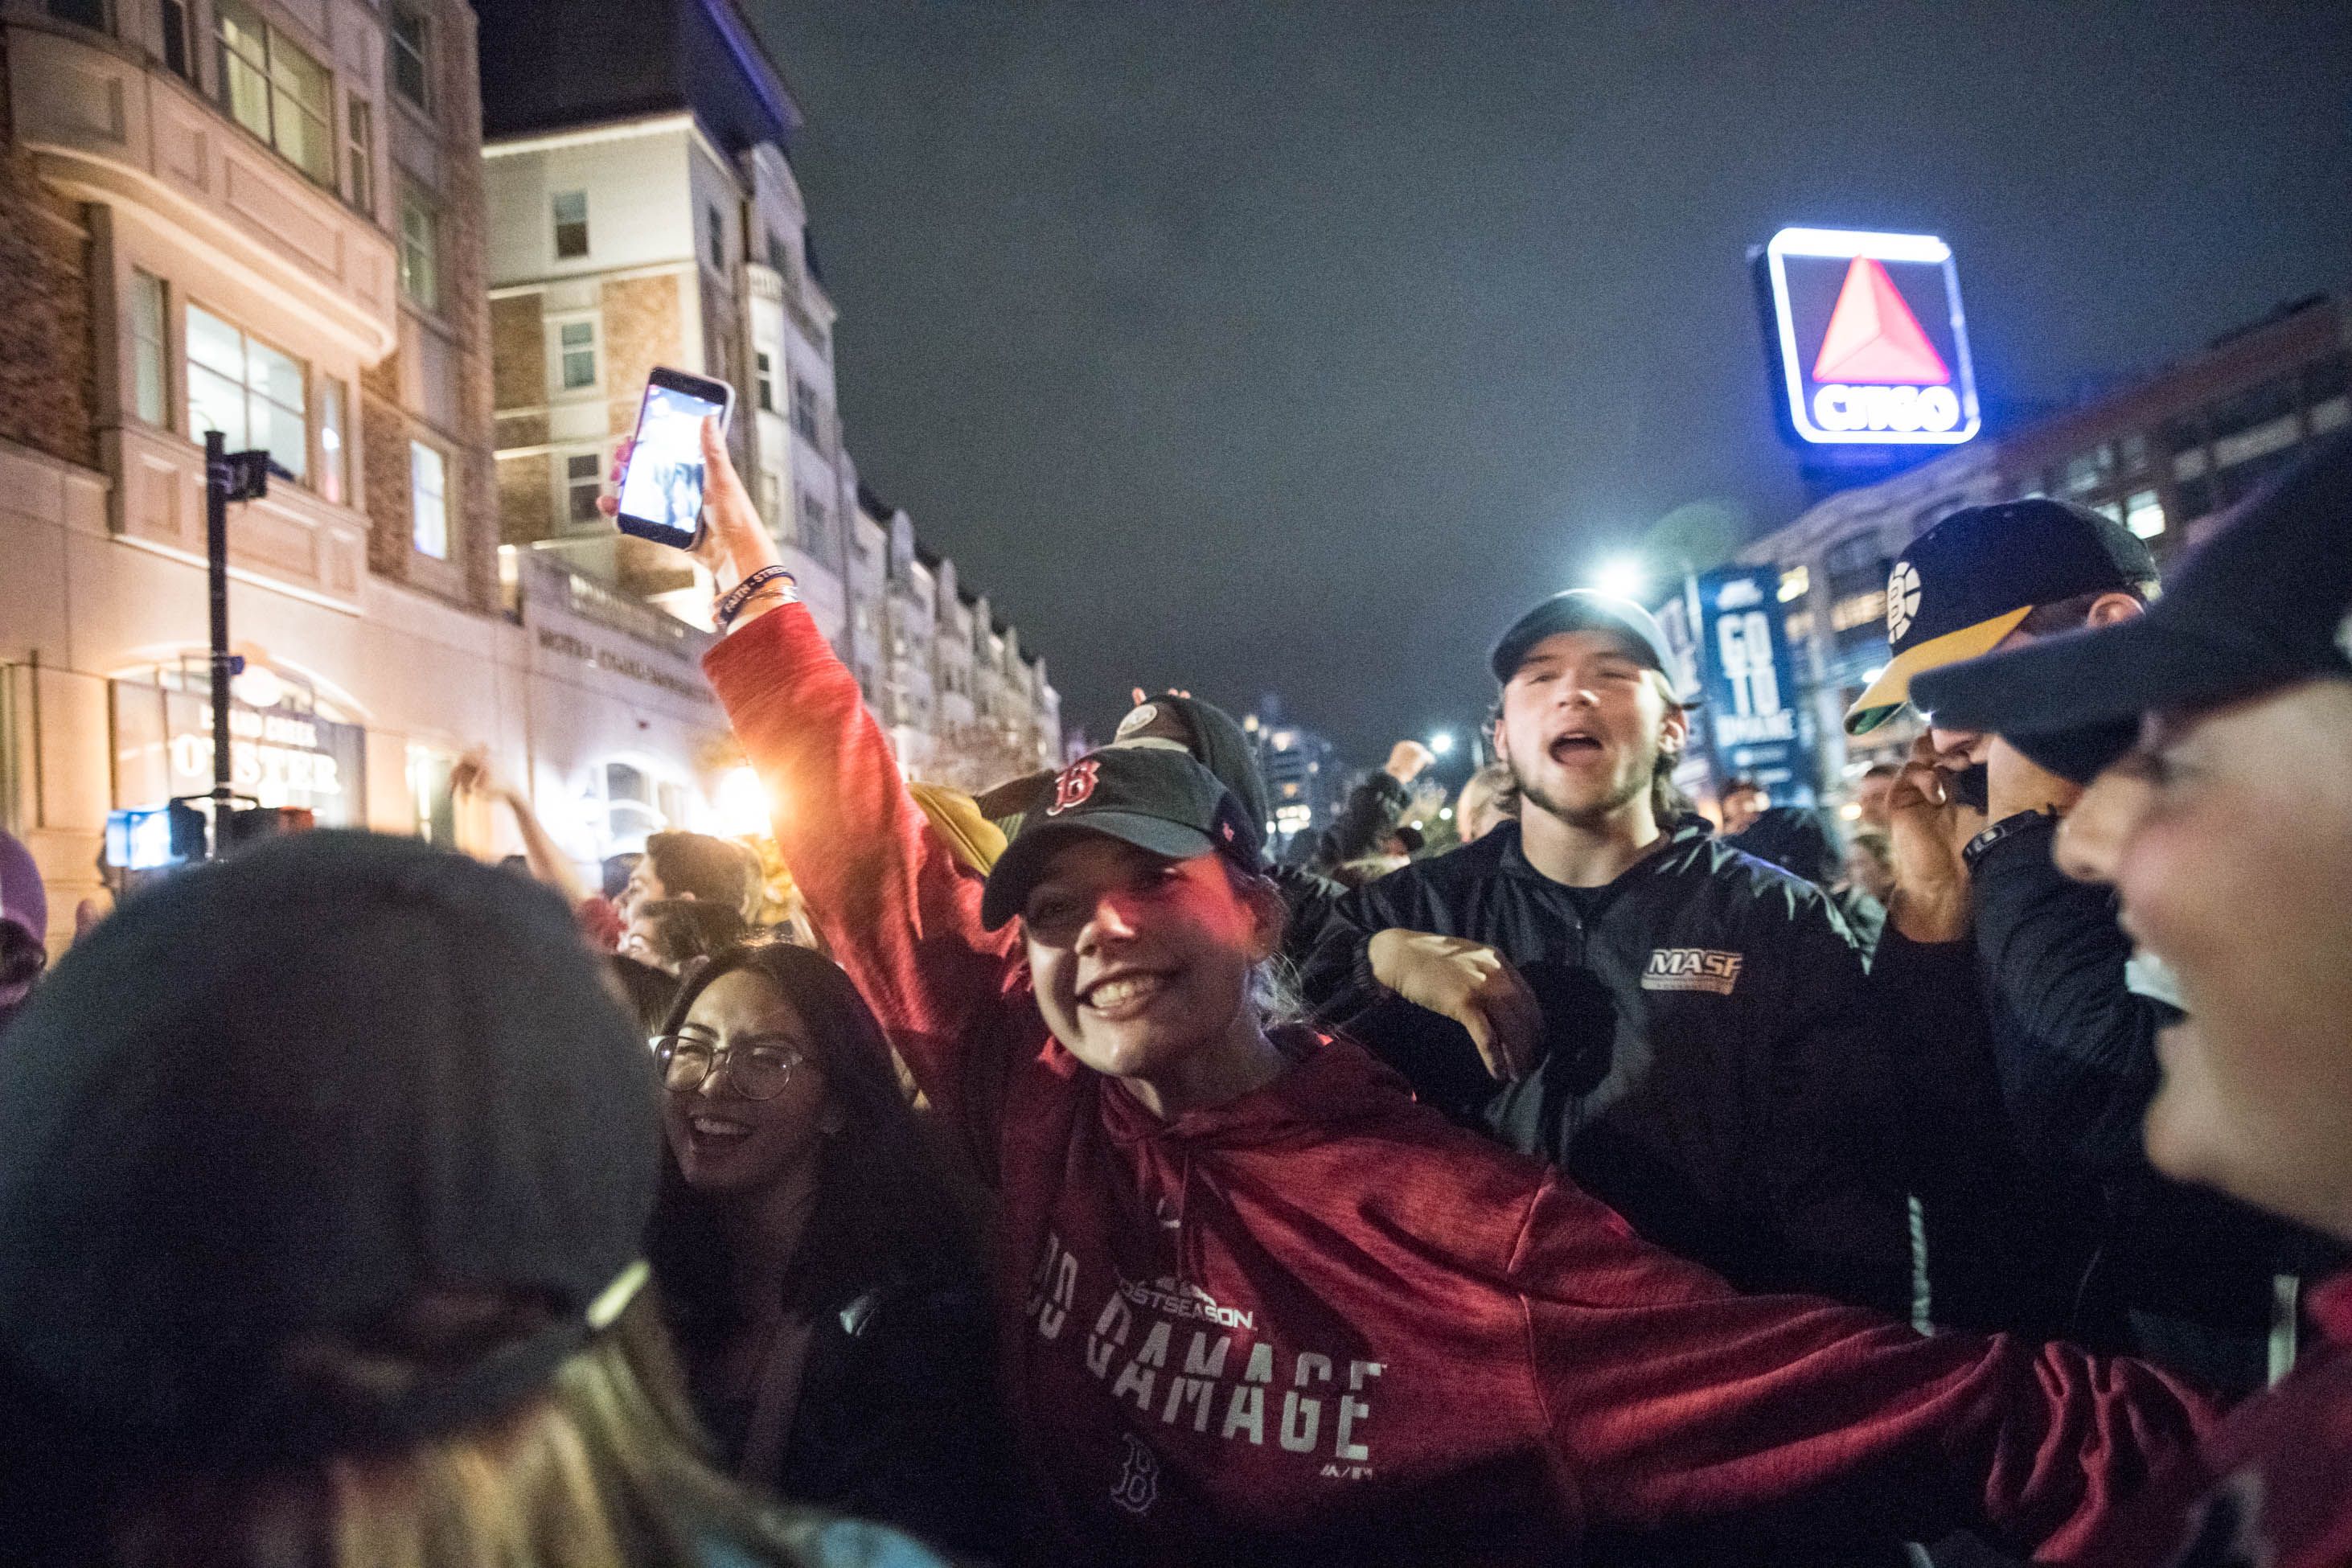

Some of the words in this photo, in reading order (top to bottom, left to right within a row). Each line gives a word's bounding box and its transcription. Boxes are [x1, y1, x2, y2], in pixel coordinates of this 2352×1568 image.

[1814, 384, 1960, 431] CITGO
[1047, 760, 1100, 816] B
[1086, 1289, 1382, 1460] DAMAGE
[1110, 1432, 1159, 1517] B
